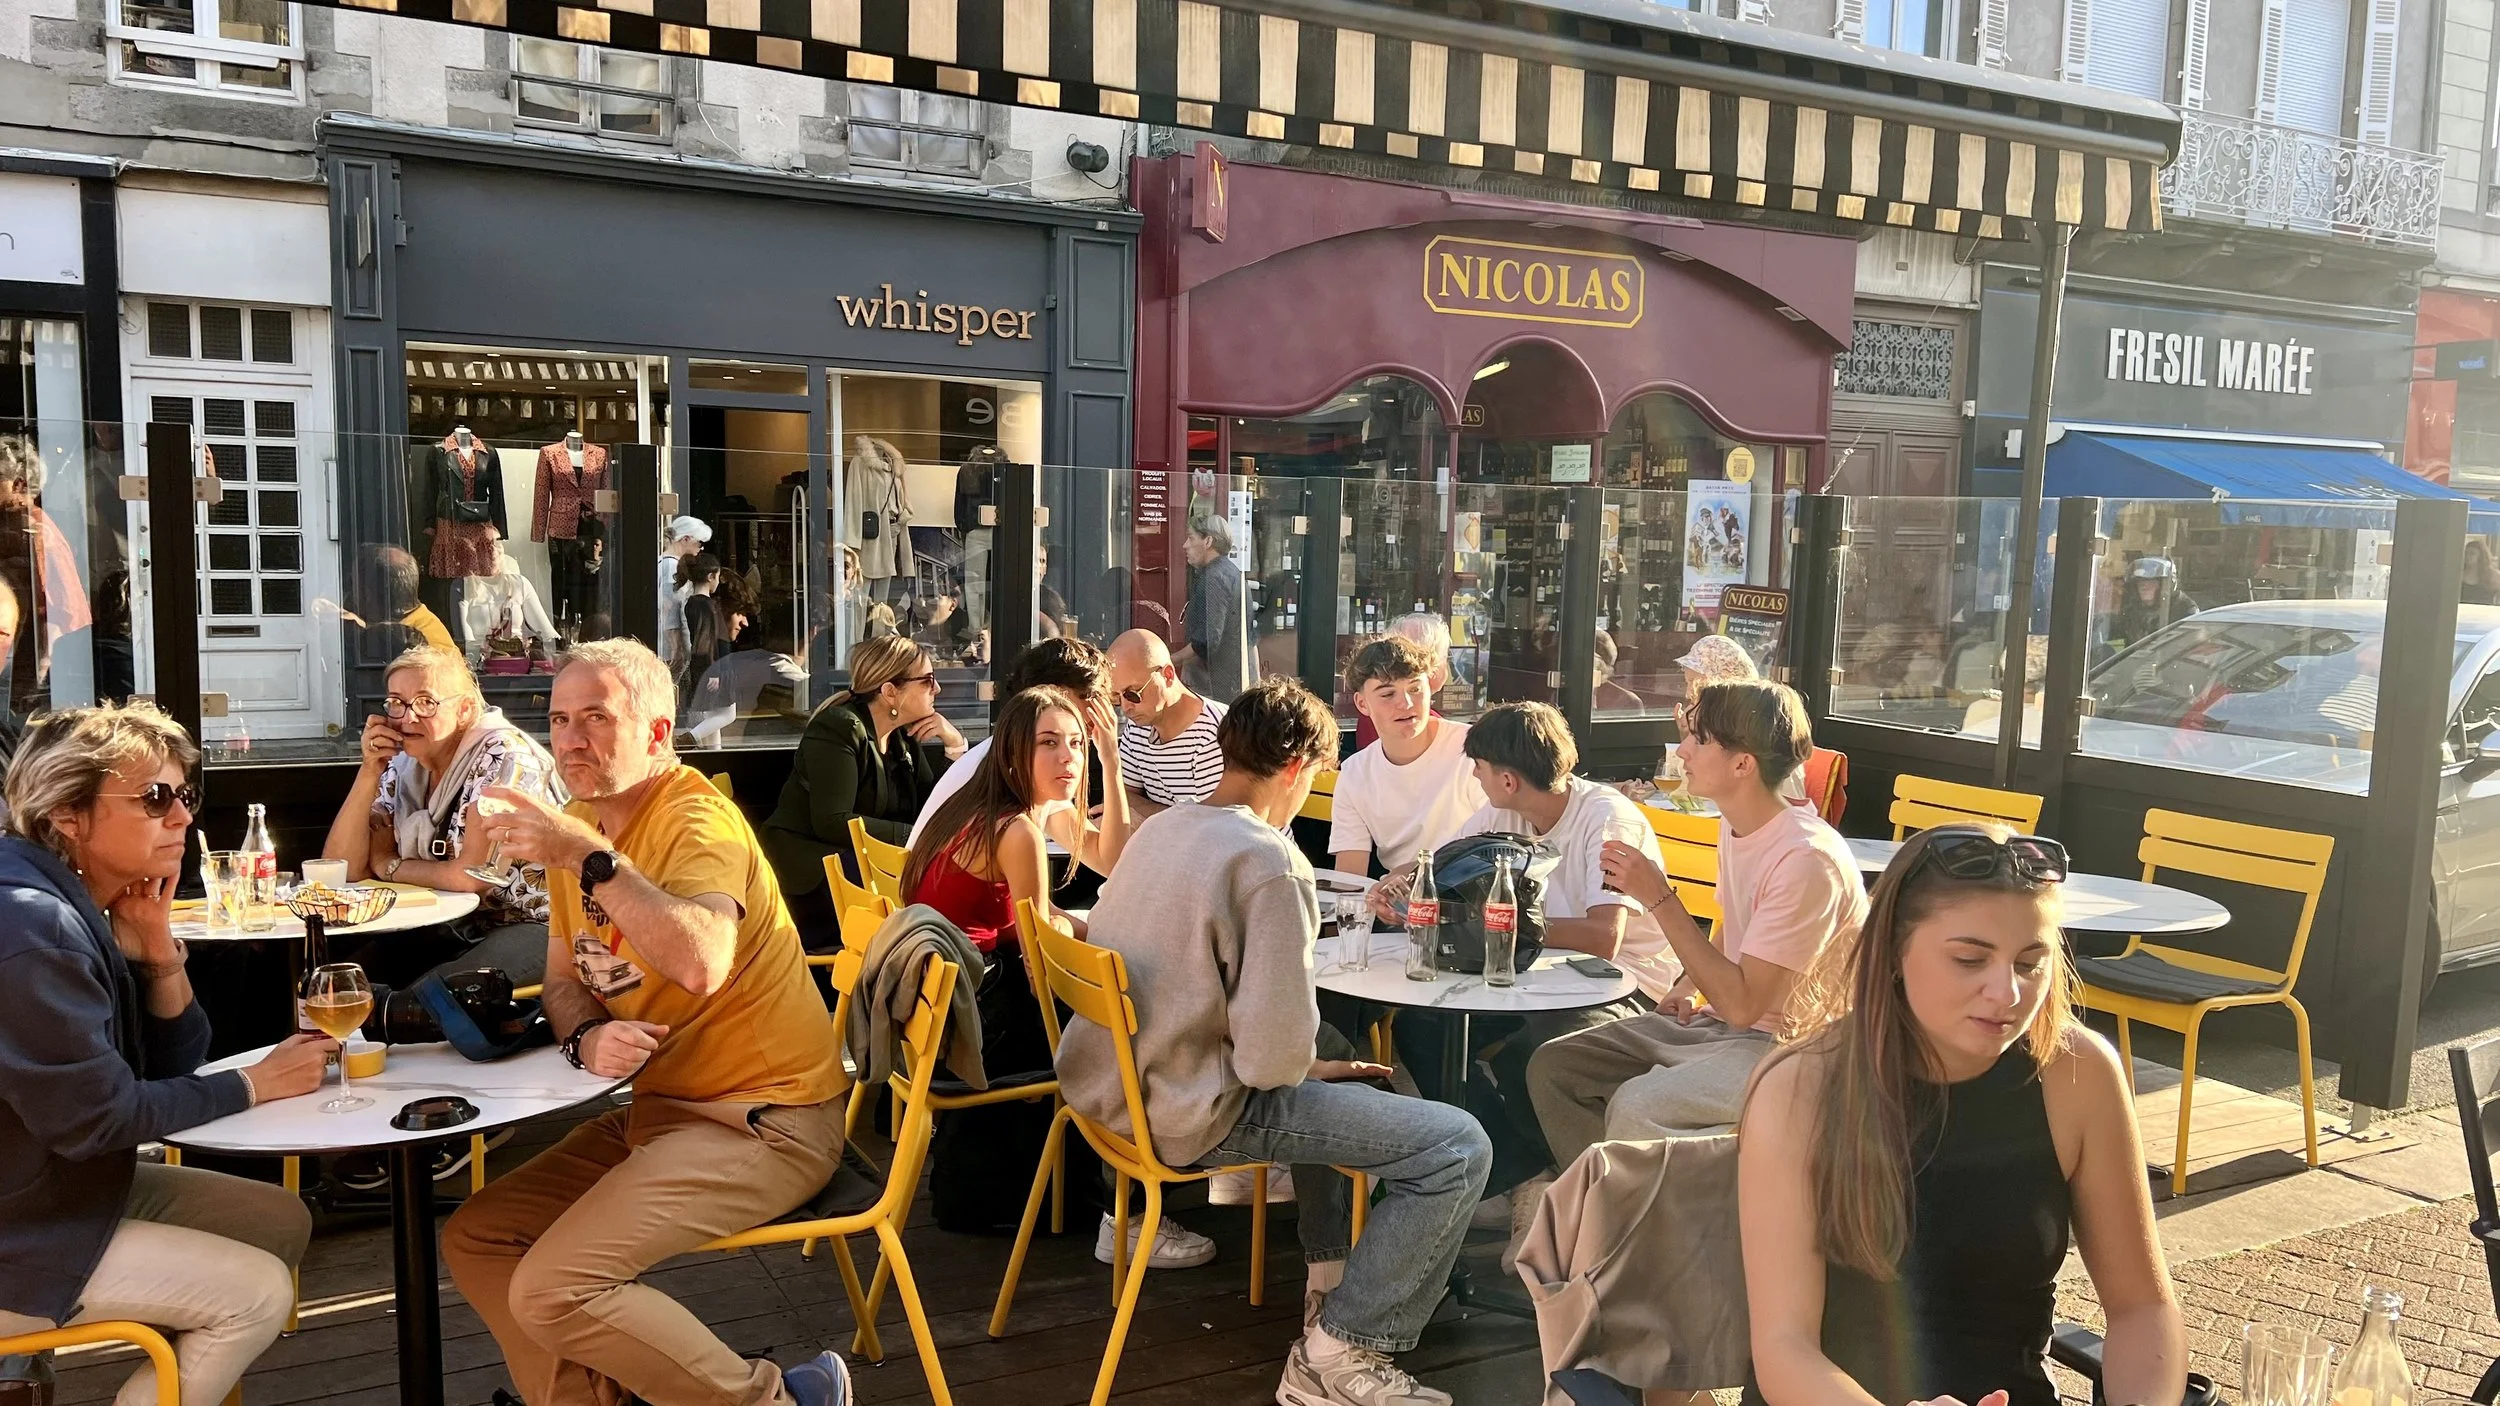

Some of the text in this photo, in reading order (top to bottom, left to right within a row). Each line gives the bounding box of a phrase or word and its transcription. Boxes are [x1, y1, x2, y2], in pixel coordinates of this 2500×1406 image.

[1438, 252, 1631, 312] NICOLAS
[836, 283, 1037, 346] whisper
[2107, 327, 2315, 395] FRESIL MARÉE
[1727, 592, 1784, 611] NICOLAS
